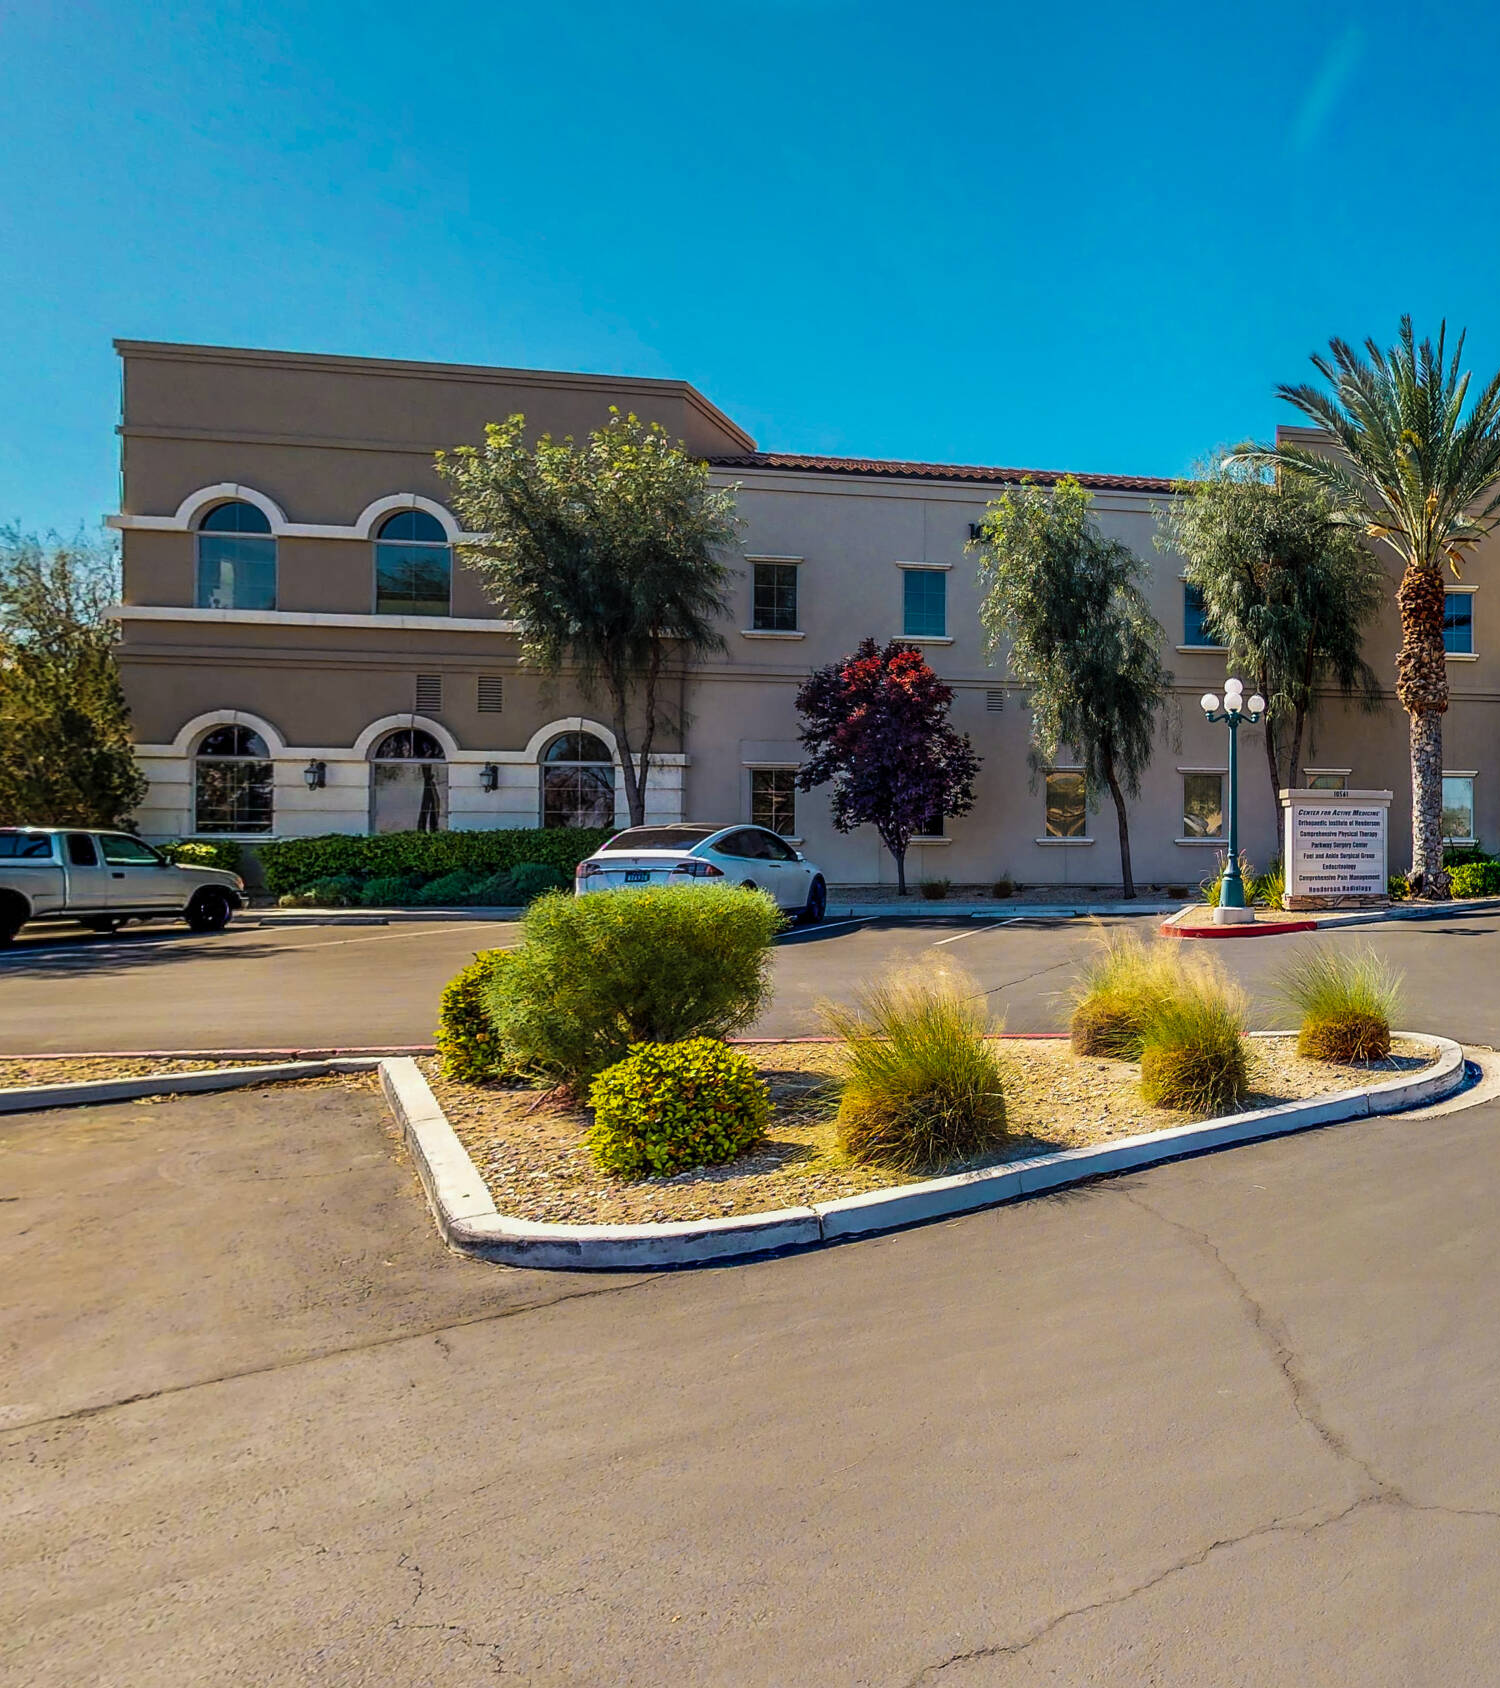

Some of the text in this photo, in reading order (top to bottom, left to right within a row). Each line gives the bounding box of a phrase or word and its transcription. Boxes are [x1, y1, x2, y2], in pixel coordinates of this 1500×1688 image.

[1352, 809, 1380, 817] MEDICINE
[1300, 830, 1378, 838] Comprehensive Physical Therapy
